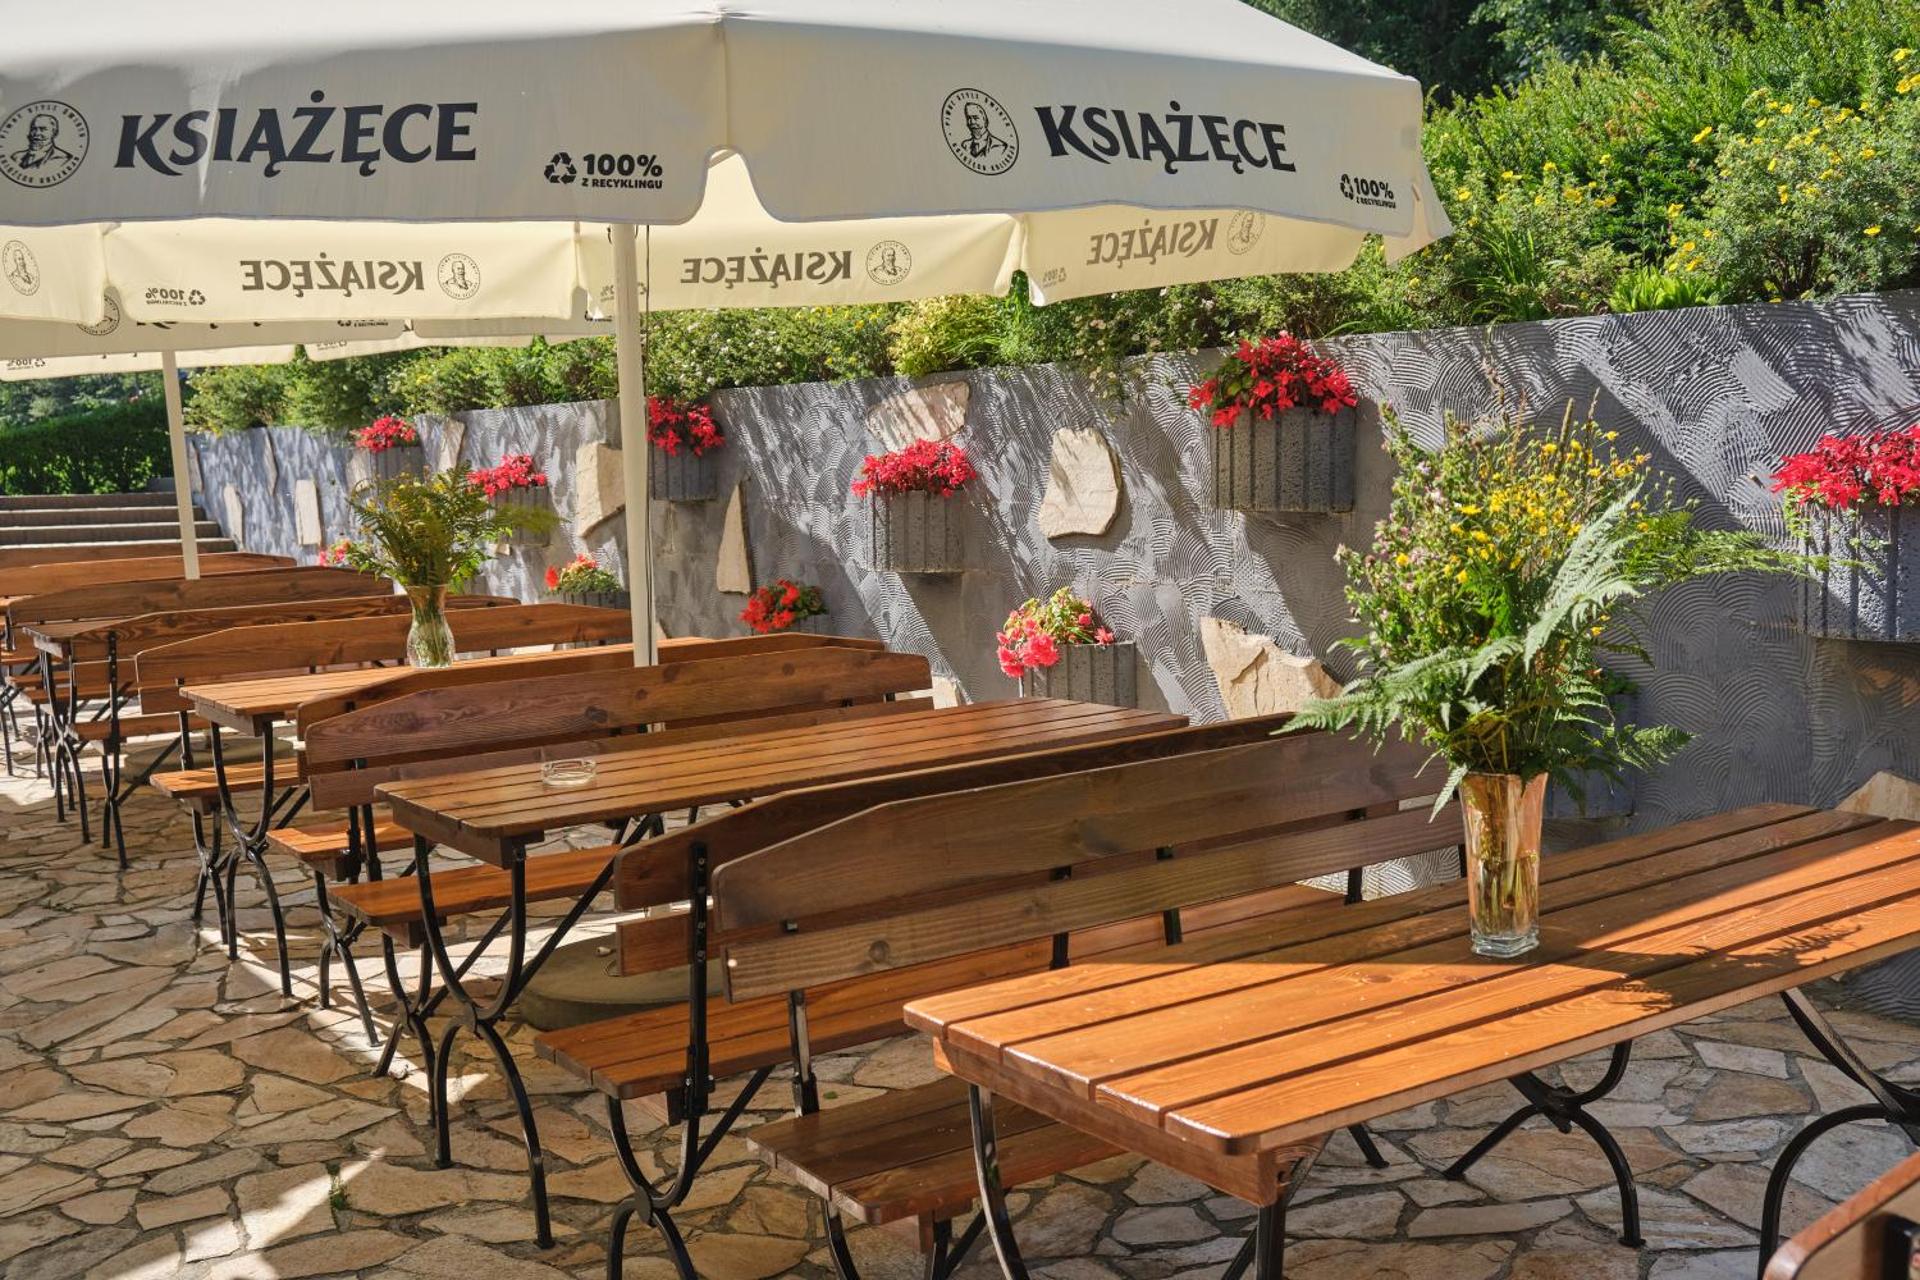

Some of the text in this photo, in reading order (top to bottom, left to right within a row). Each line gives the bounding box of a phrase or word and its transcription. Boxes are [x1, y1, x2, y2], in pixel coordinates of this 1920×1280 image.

[115, 90, 478, 177] KSIĄŻĘCE
[1034, 100, 1296, 175] KSIĄŻĘCE
[583, 153, 663, 177] 100%
[581, 178, 663, 189] Z RECYKLINGU
[1353, 177, 1394, 200] 100%
